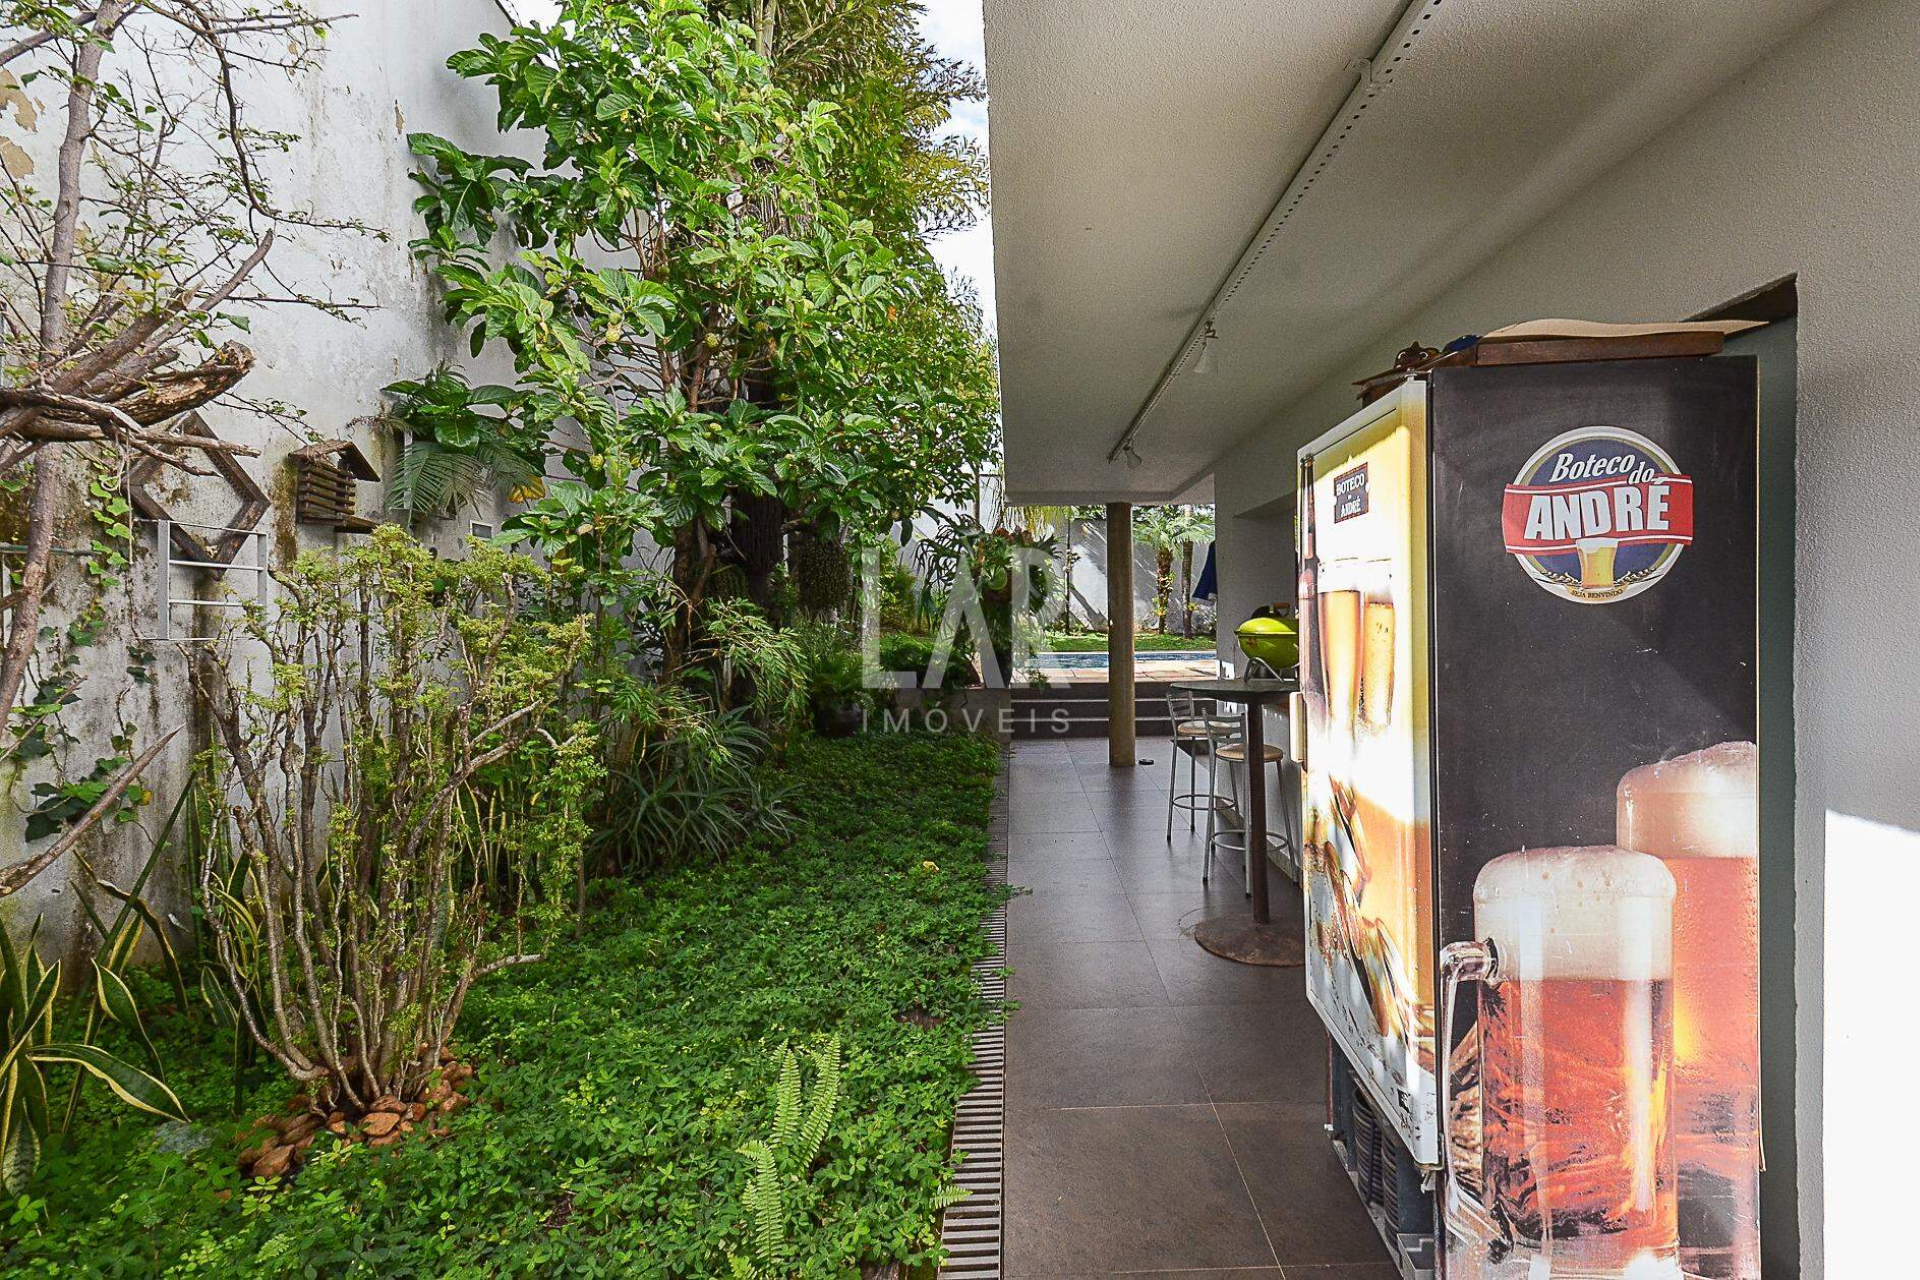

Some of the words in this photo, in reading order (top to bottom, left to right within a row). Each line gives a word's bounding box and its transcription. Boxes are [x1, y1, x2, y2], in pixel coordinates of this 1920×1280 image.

[1549, 453, 1636, 482] Boteco
[1628, 461, 1655, 485] do
[1336, 472, 1365, 497] BOTECO
[1340, 495, 1361, 517] ANDRÉ
[1523, 477, 1670, 540] ANDRÉ
